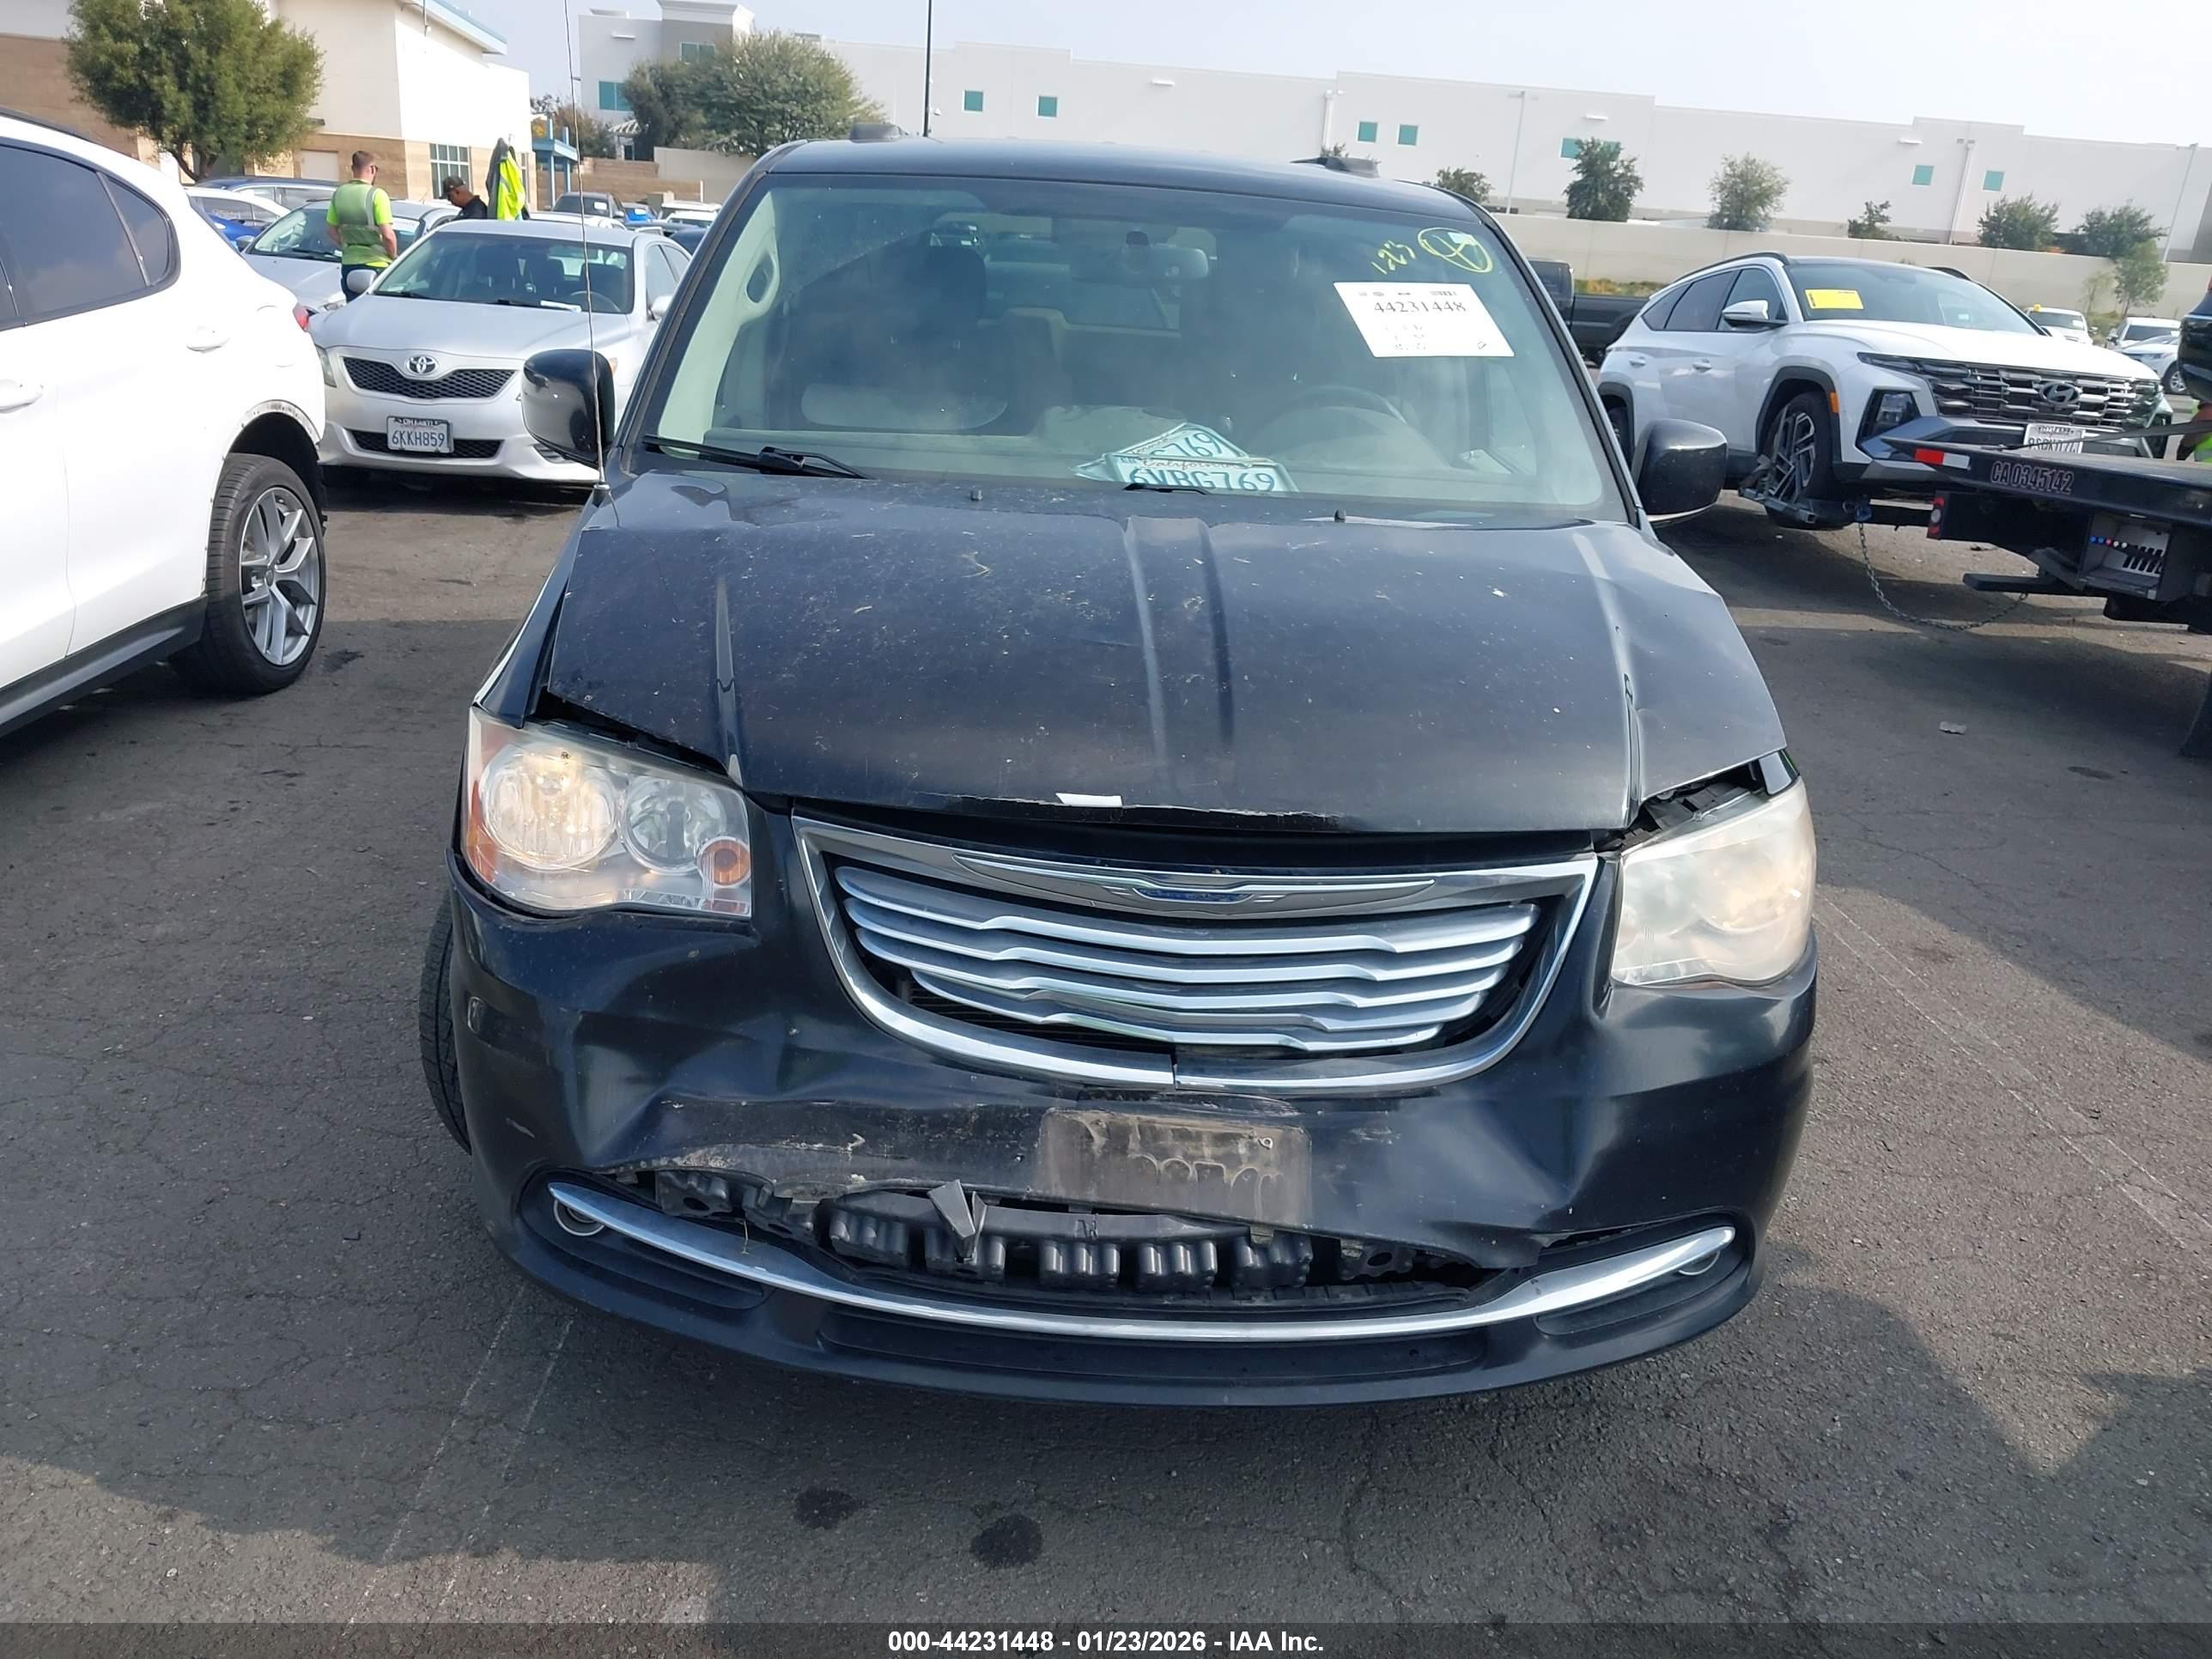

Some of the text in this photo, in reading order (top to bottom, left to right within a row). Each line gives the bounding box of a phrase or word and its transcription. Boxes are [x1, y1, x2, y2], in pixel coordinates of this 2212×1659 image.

[1375, 301, 1467, 313] 44231448
[392, 430, 445, 447] 6KKH859
[1990, 460, 2075, 495] CA 0345142
